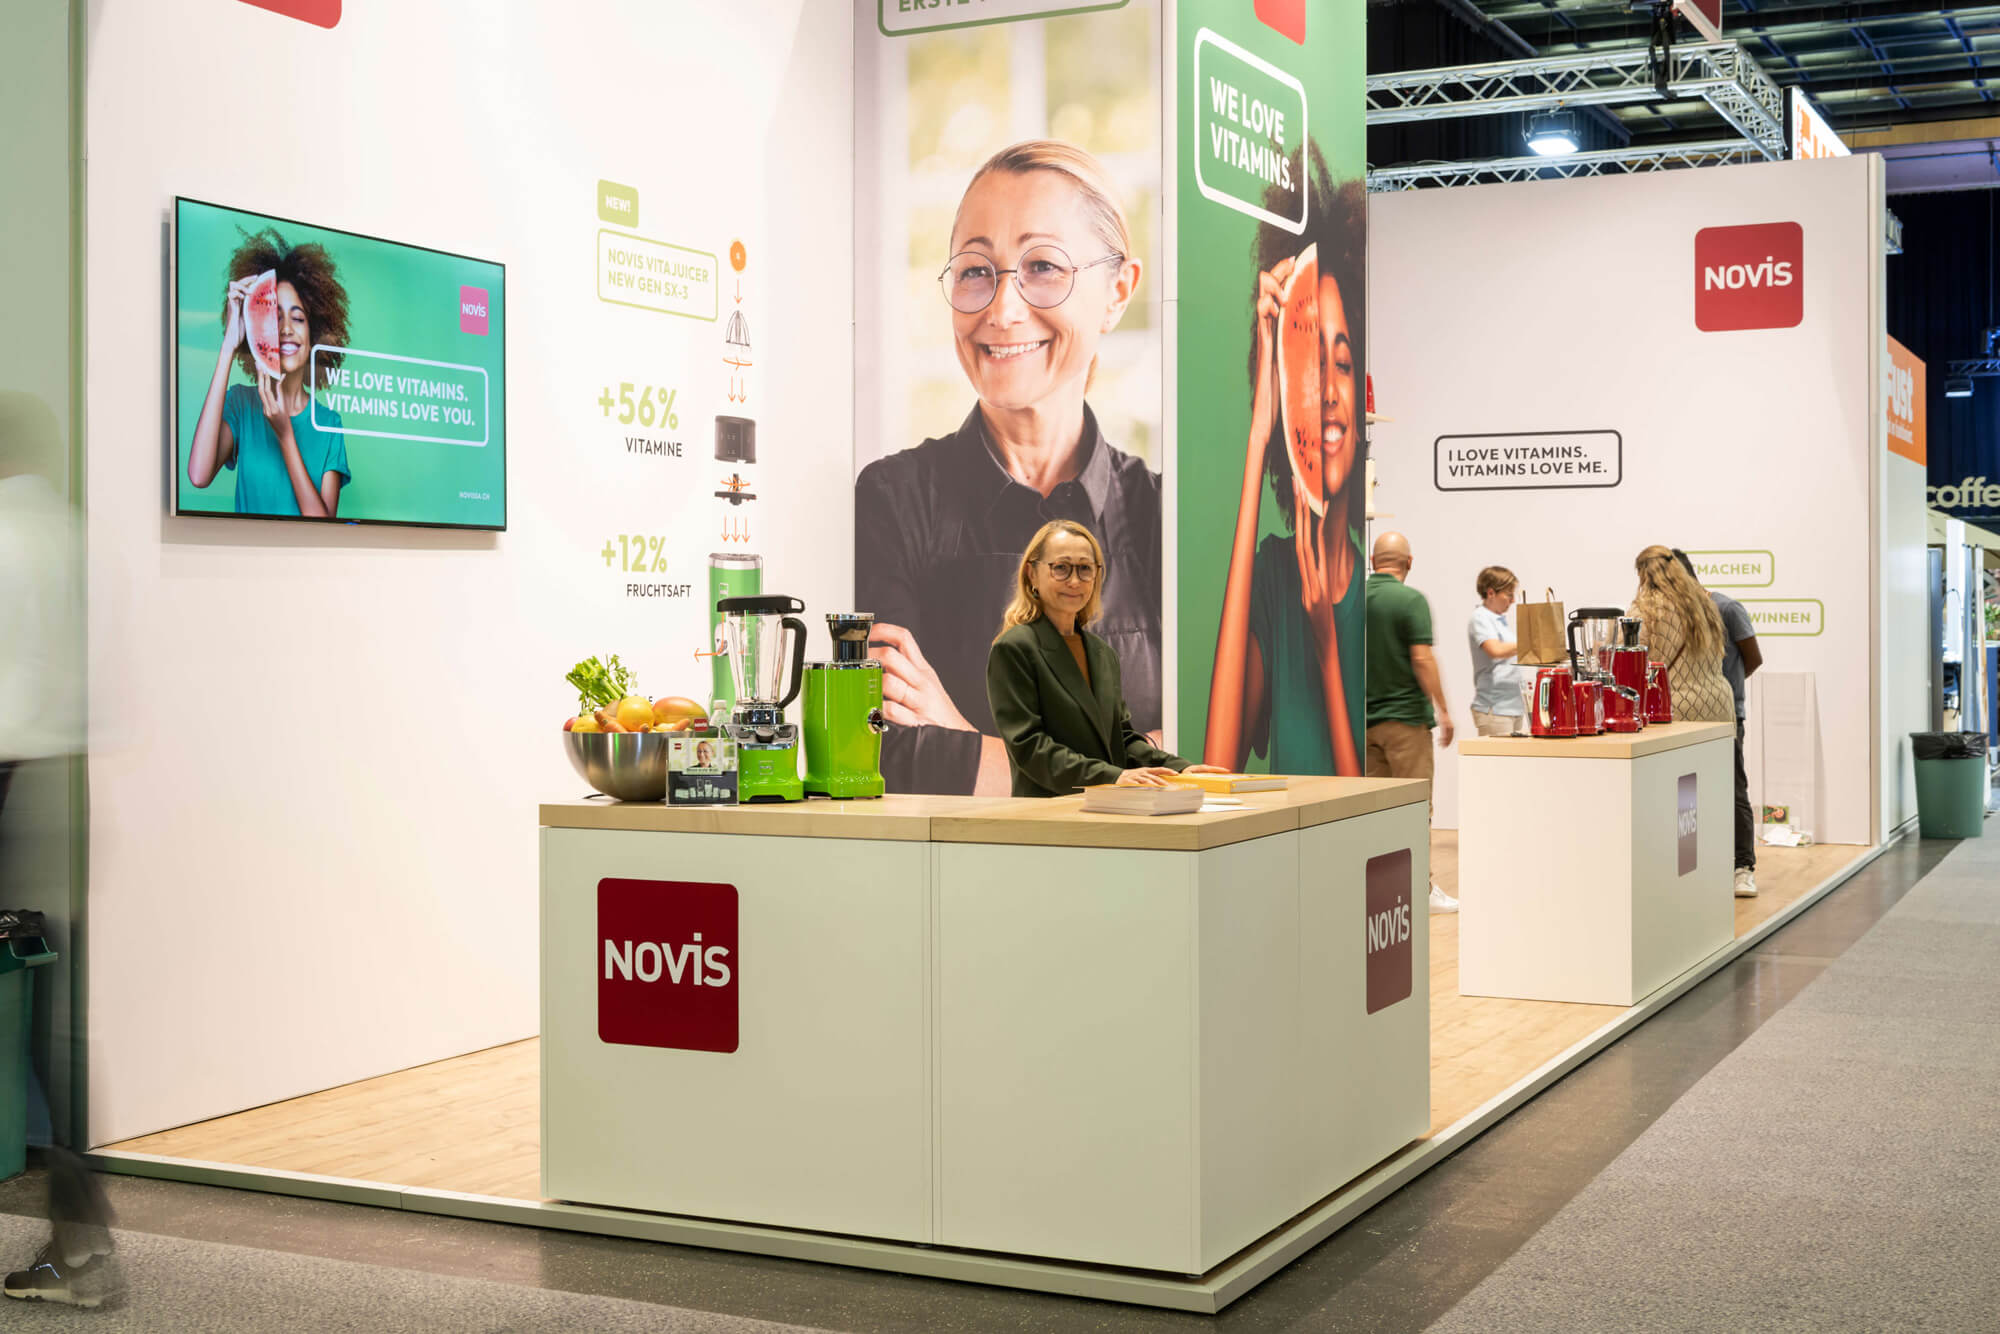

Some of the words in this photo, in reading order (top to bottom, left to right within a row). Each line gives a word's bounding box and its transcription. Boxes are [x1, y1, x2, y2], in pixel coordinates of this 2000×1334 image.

[1209, 76, 1239, 123] WE
[1241, 93, 1285, 145] LOVE
[1209, 122, 1295, 193] VITAMINS.
[605, 195, 632, 213] NEW!
[608, 247, 644, 270] NOVIS
[646, 256, 709, 283] VITAJUICER
[608, 269, 636, 289] NEW
[638, 276, 662, 296] GEN
[664, 281, 689, 301] SX-3
[325, 367, 350, 388] WE
[354, 371, 394, 393] LOVE
[397, 376, 469, 403] VITAMINS.
[325, 392, 398, 418] VITAMINS
[401, 402, 439, 422] LOVE
[442, 407, 476, 427] YOU.
[598, 382, 679, 431] +56%
[625, 436, 683, 458] VITAMINE
[1448, 449, 1453, 462] I
[1457, 448, 1500, 462] LOVE
[1503, 446, 1588, 460] VITAMINS.
[1448, 463, 1526, 477] VITAMINS
[1530, 461, 1574, 475] LOVE
[1578, 461, 1608, 474] ME.
[601, 534, 668, 574] +12%
[1692, 563, 1762, 575] MACHEN
[626, 583, 692, 598] FRUCHTSAFT
